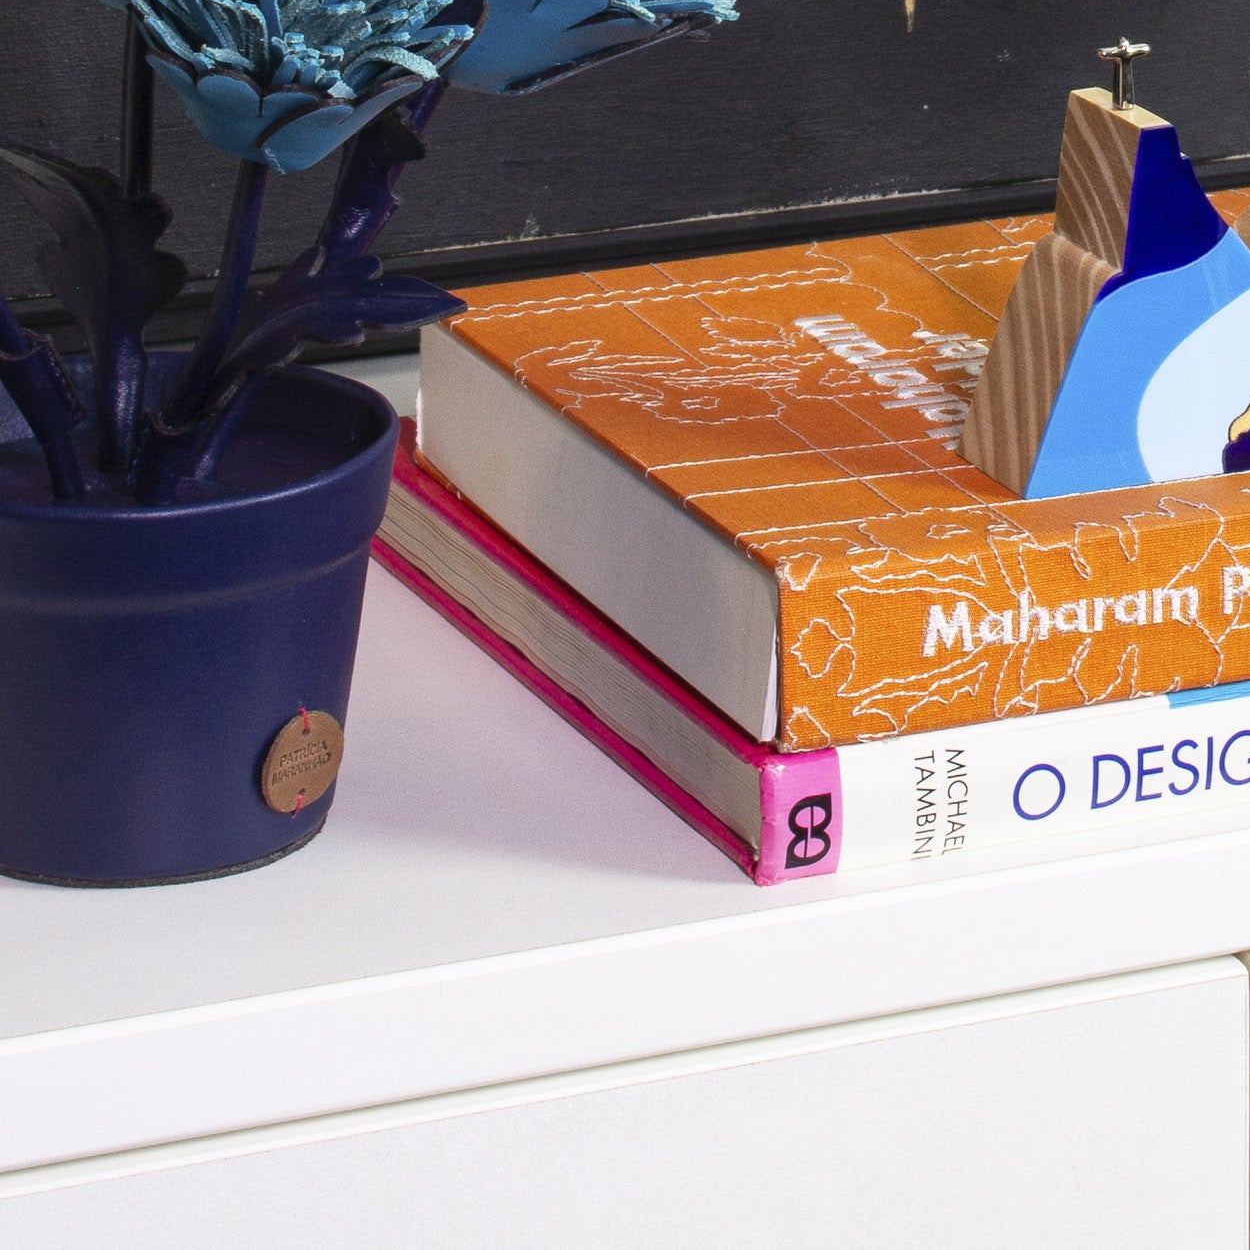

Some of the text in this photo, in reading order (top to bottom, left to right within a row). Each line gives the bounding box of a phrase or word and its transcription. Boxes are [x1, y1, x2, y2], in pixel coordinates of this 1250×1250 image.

[922, 583, 1199, 658] Maharam
[910, 749, 938, 861] TAMBINI
[941, 749, 968, 855] MICHAEL
[1012, 763, 1066, 821] O
